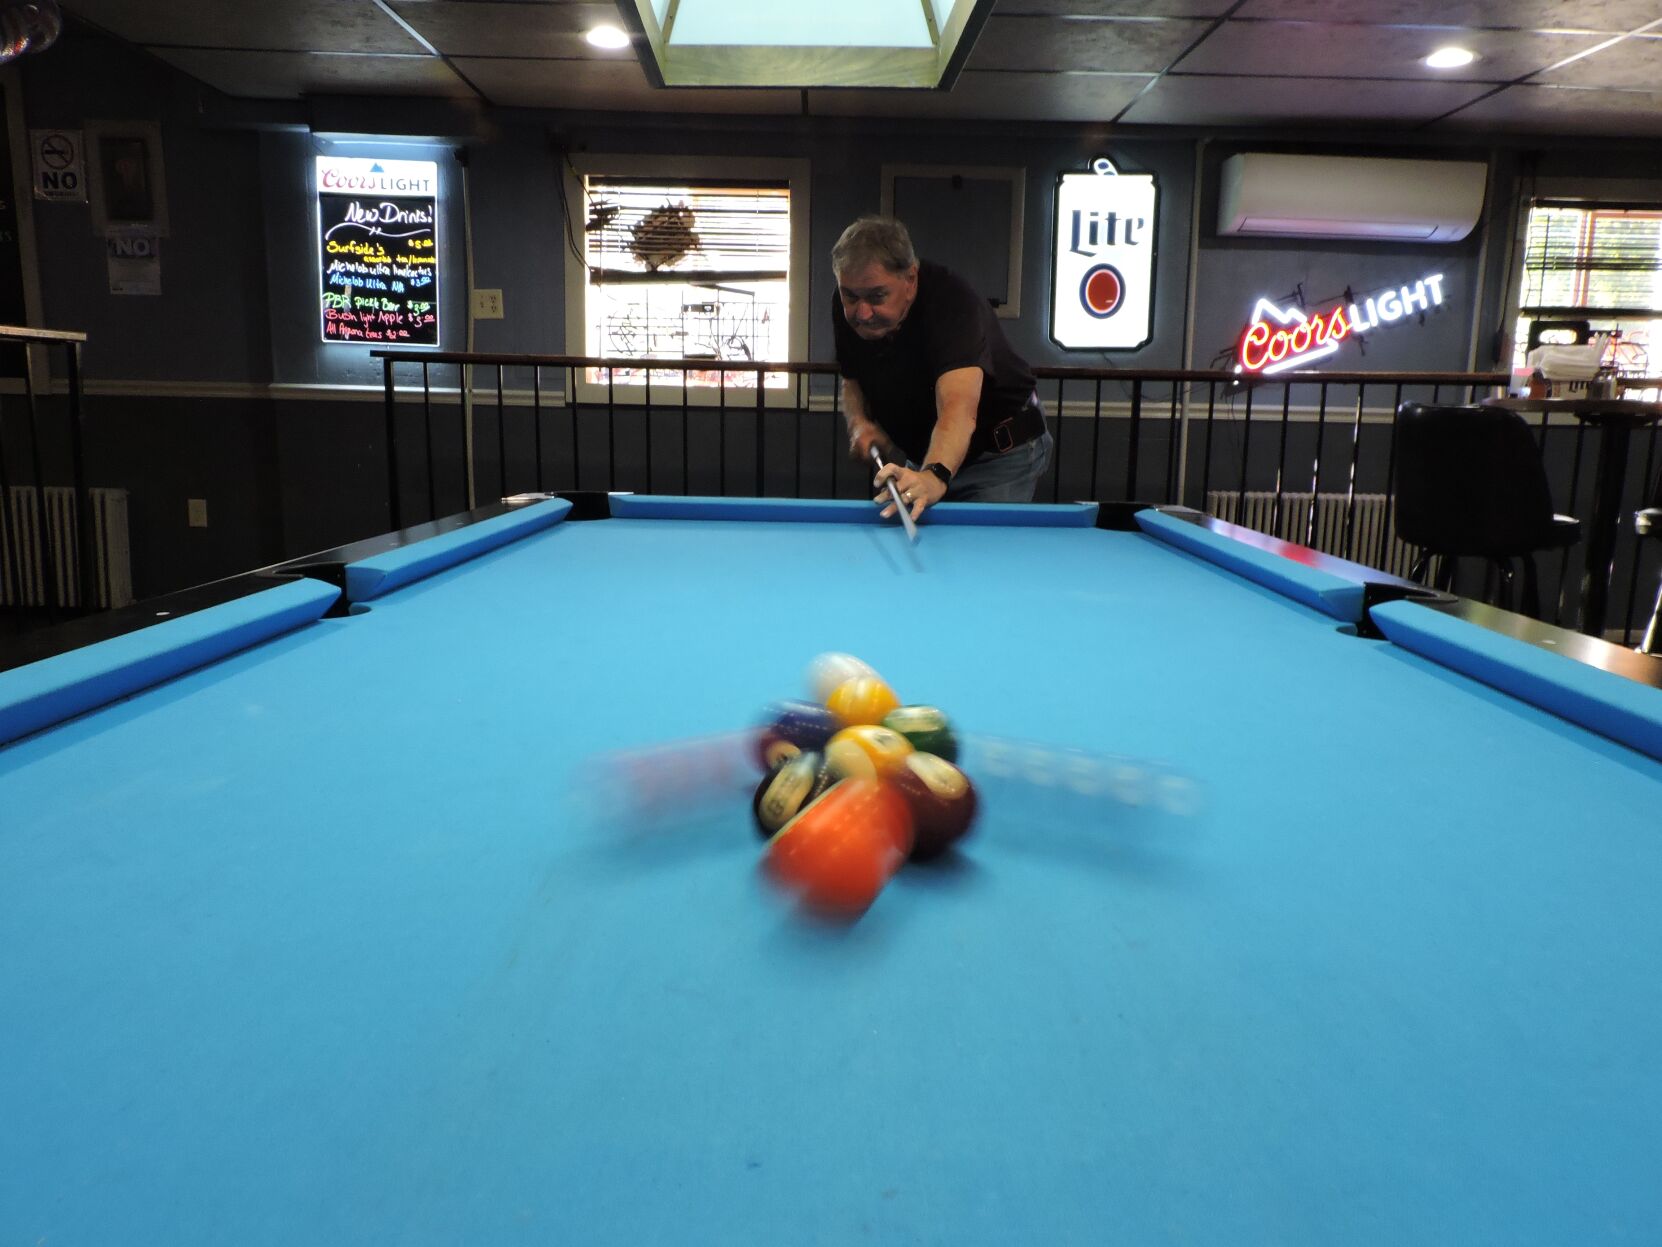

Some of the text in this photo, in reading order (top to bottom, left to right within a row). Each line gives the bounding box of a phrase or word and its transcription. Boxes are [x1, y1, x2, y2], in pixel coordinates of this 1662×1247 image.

[41, 171, 77, 189] NO
[322, 168, 430, 191] Coors LIGHT
[344, 201, 432, 224] New Drinks!
[1069, 209, 1144, 257] Lite
[329, 272, 364, 286] Michelob
[322, 292, 351, 309] PBR
[378, 311, 403, 325] Apple
[1242, 273, 1444, 370] Coors LIGHT
